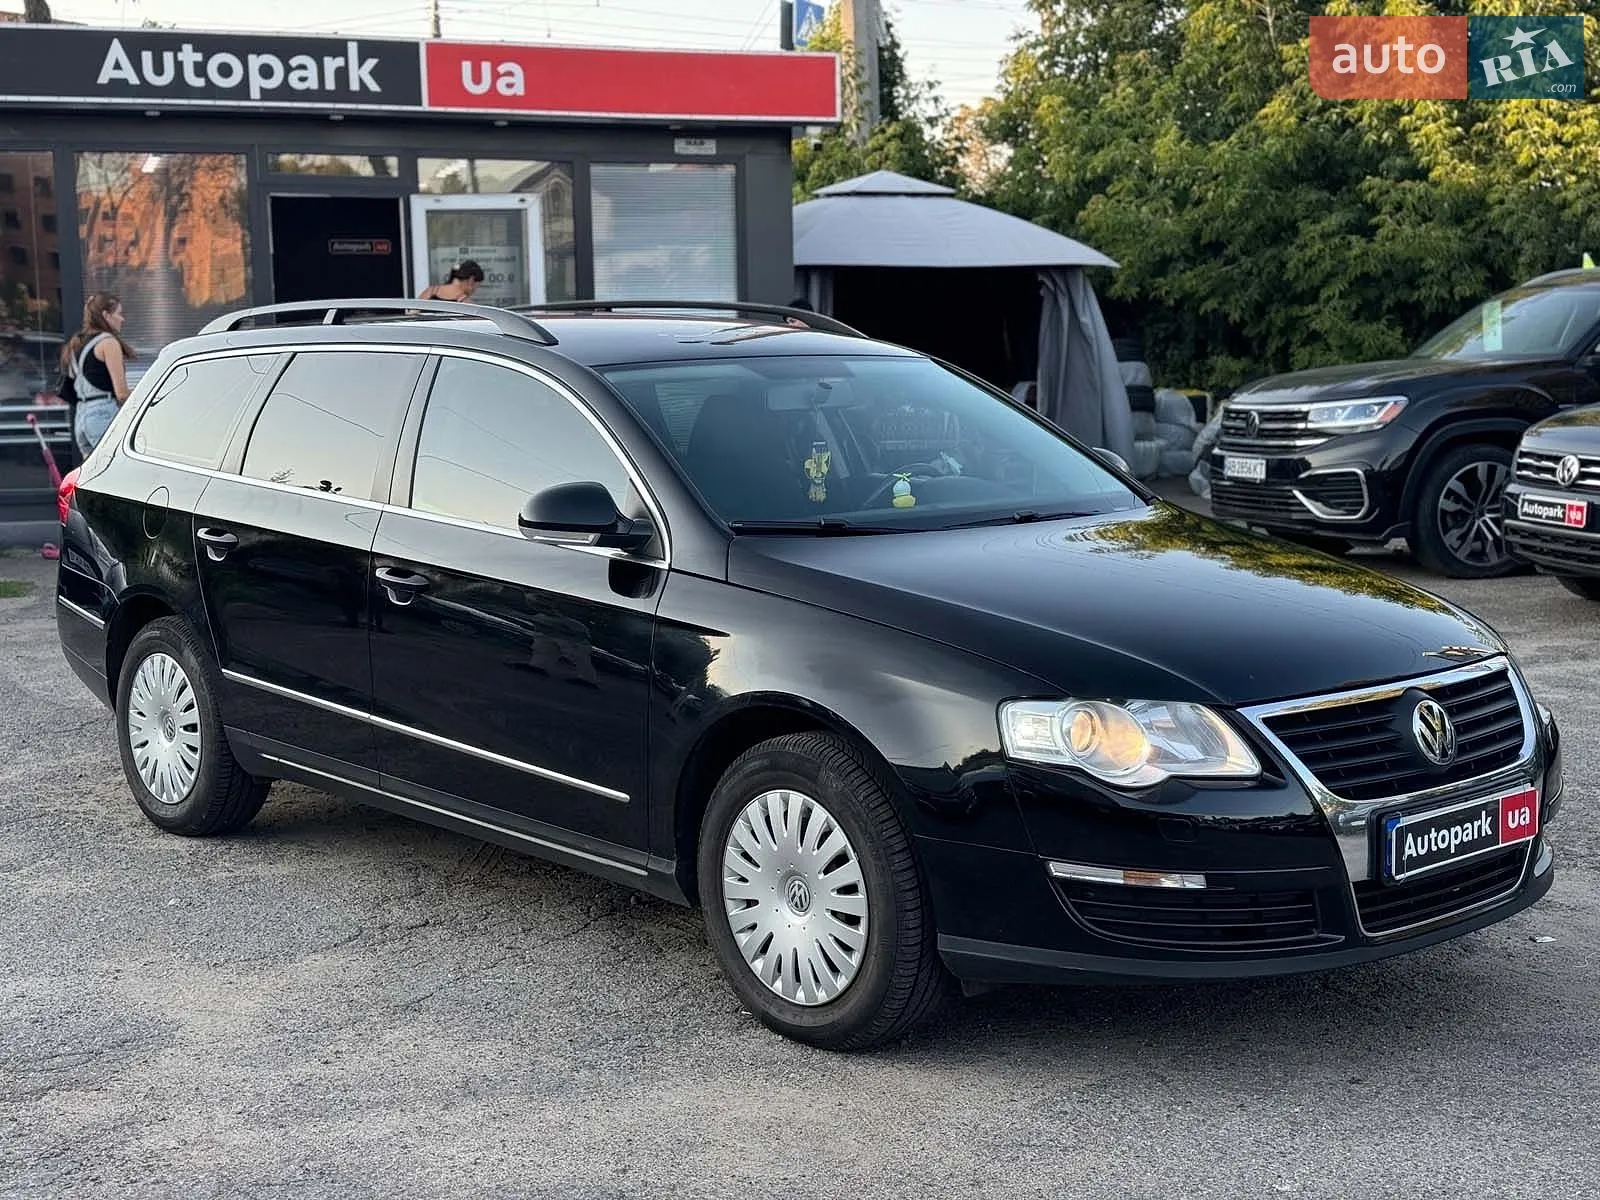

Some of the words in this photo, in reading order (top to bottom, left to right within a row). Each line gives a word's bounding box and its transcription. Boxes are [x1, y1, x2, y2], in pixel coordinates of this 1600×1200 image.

[97, 37, 382, 100] Autopark
[460, 58, 526, 97] ua
[1521, 501, 1565, 519] Autopark
[1402, 810, 1493, 861] Autopark
[1507, 805, 1531, 829] ua
